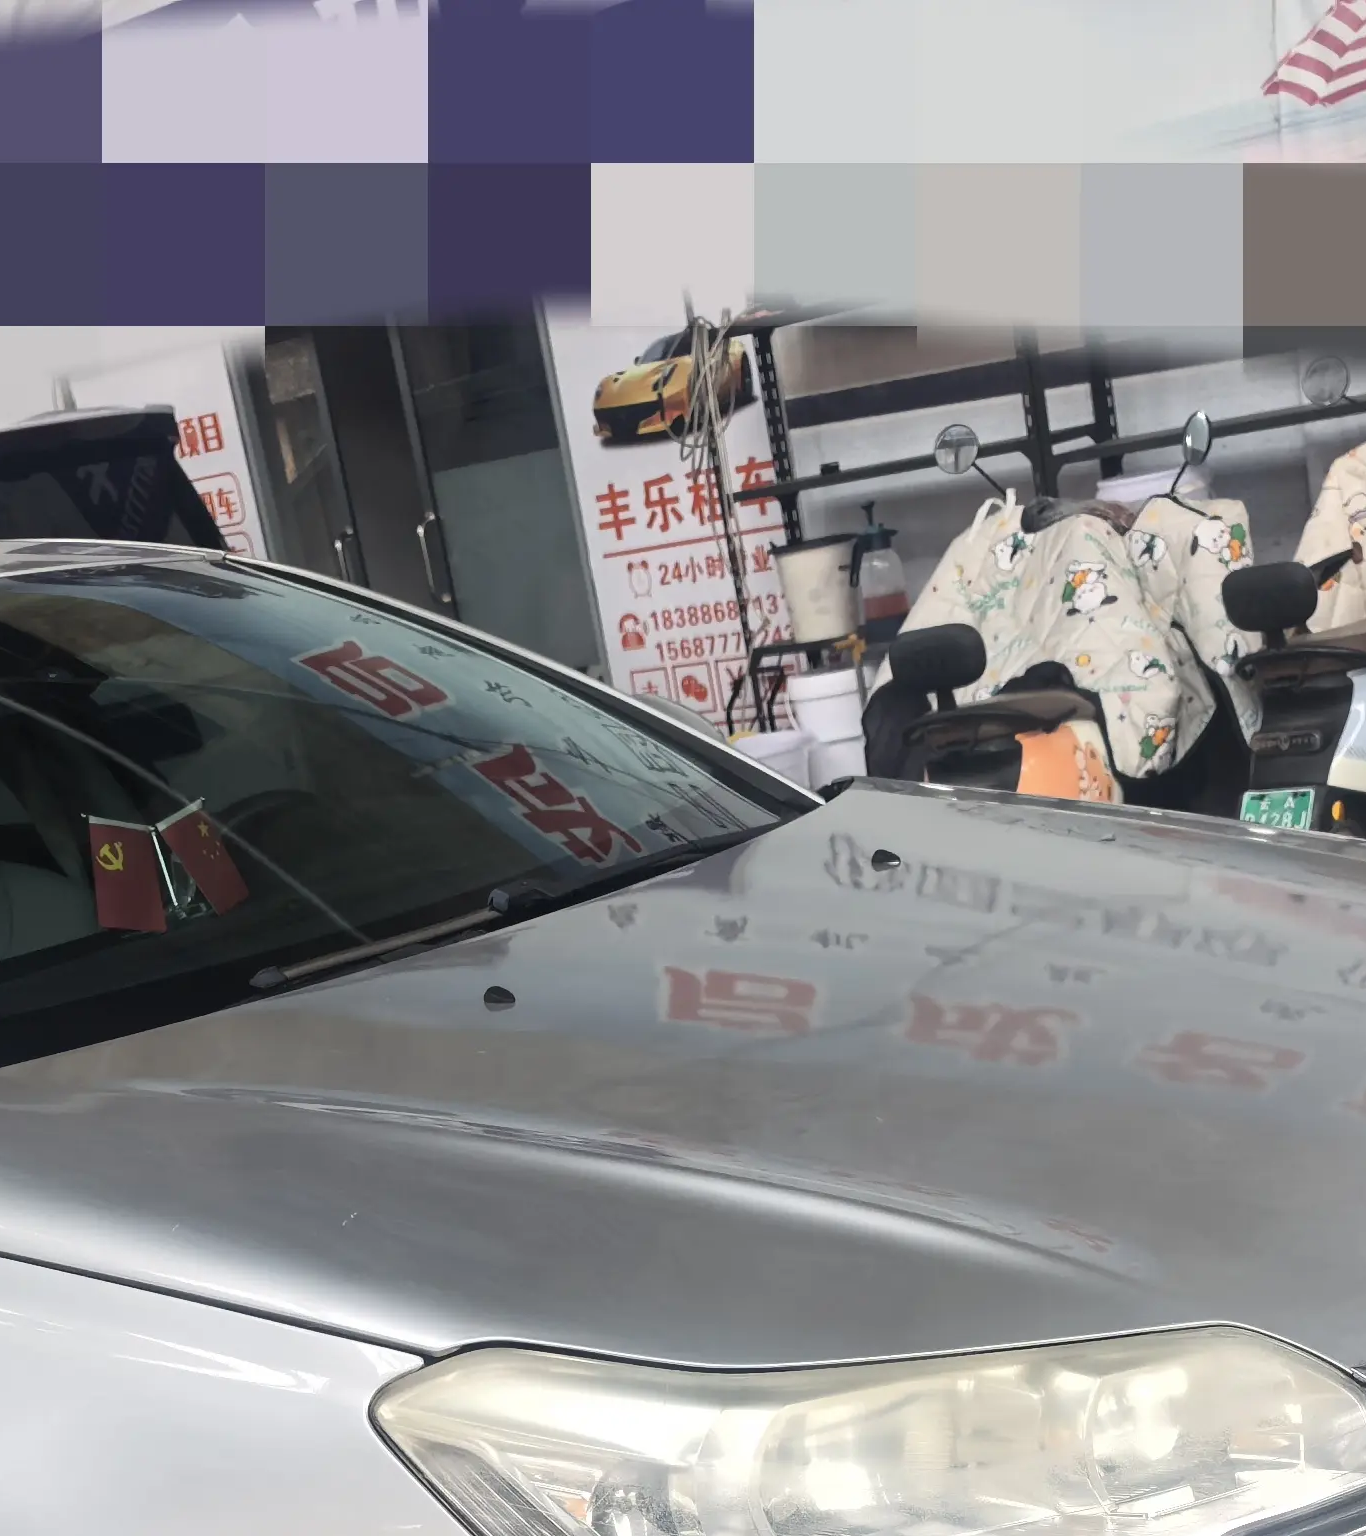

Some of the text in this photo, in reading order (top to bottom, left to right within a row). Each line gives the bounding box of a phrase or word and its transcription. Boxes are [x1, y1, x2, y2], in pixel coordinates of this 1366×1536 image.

[595, 456, 776, 541] 丰乐租车
[658, 545, 773, 586] 24小时业
